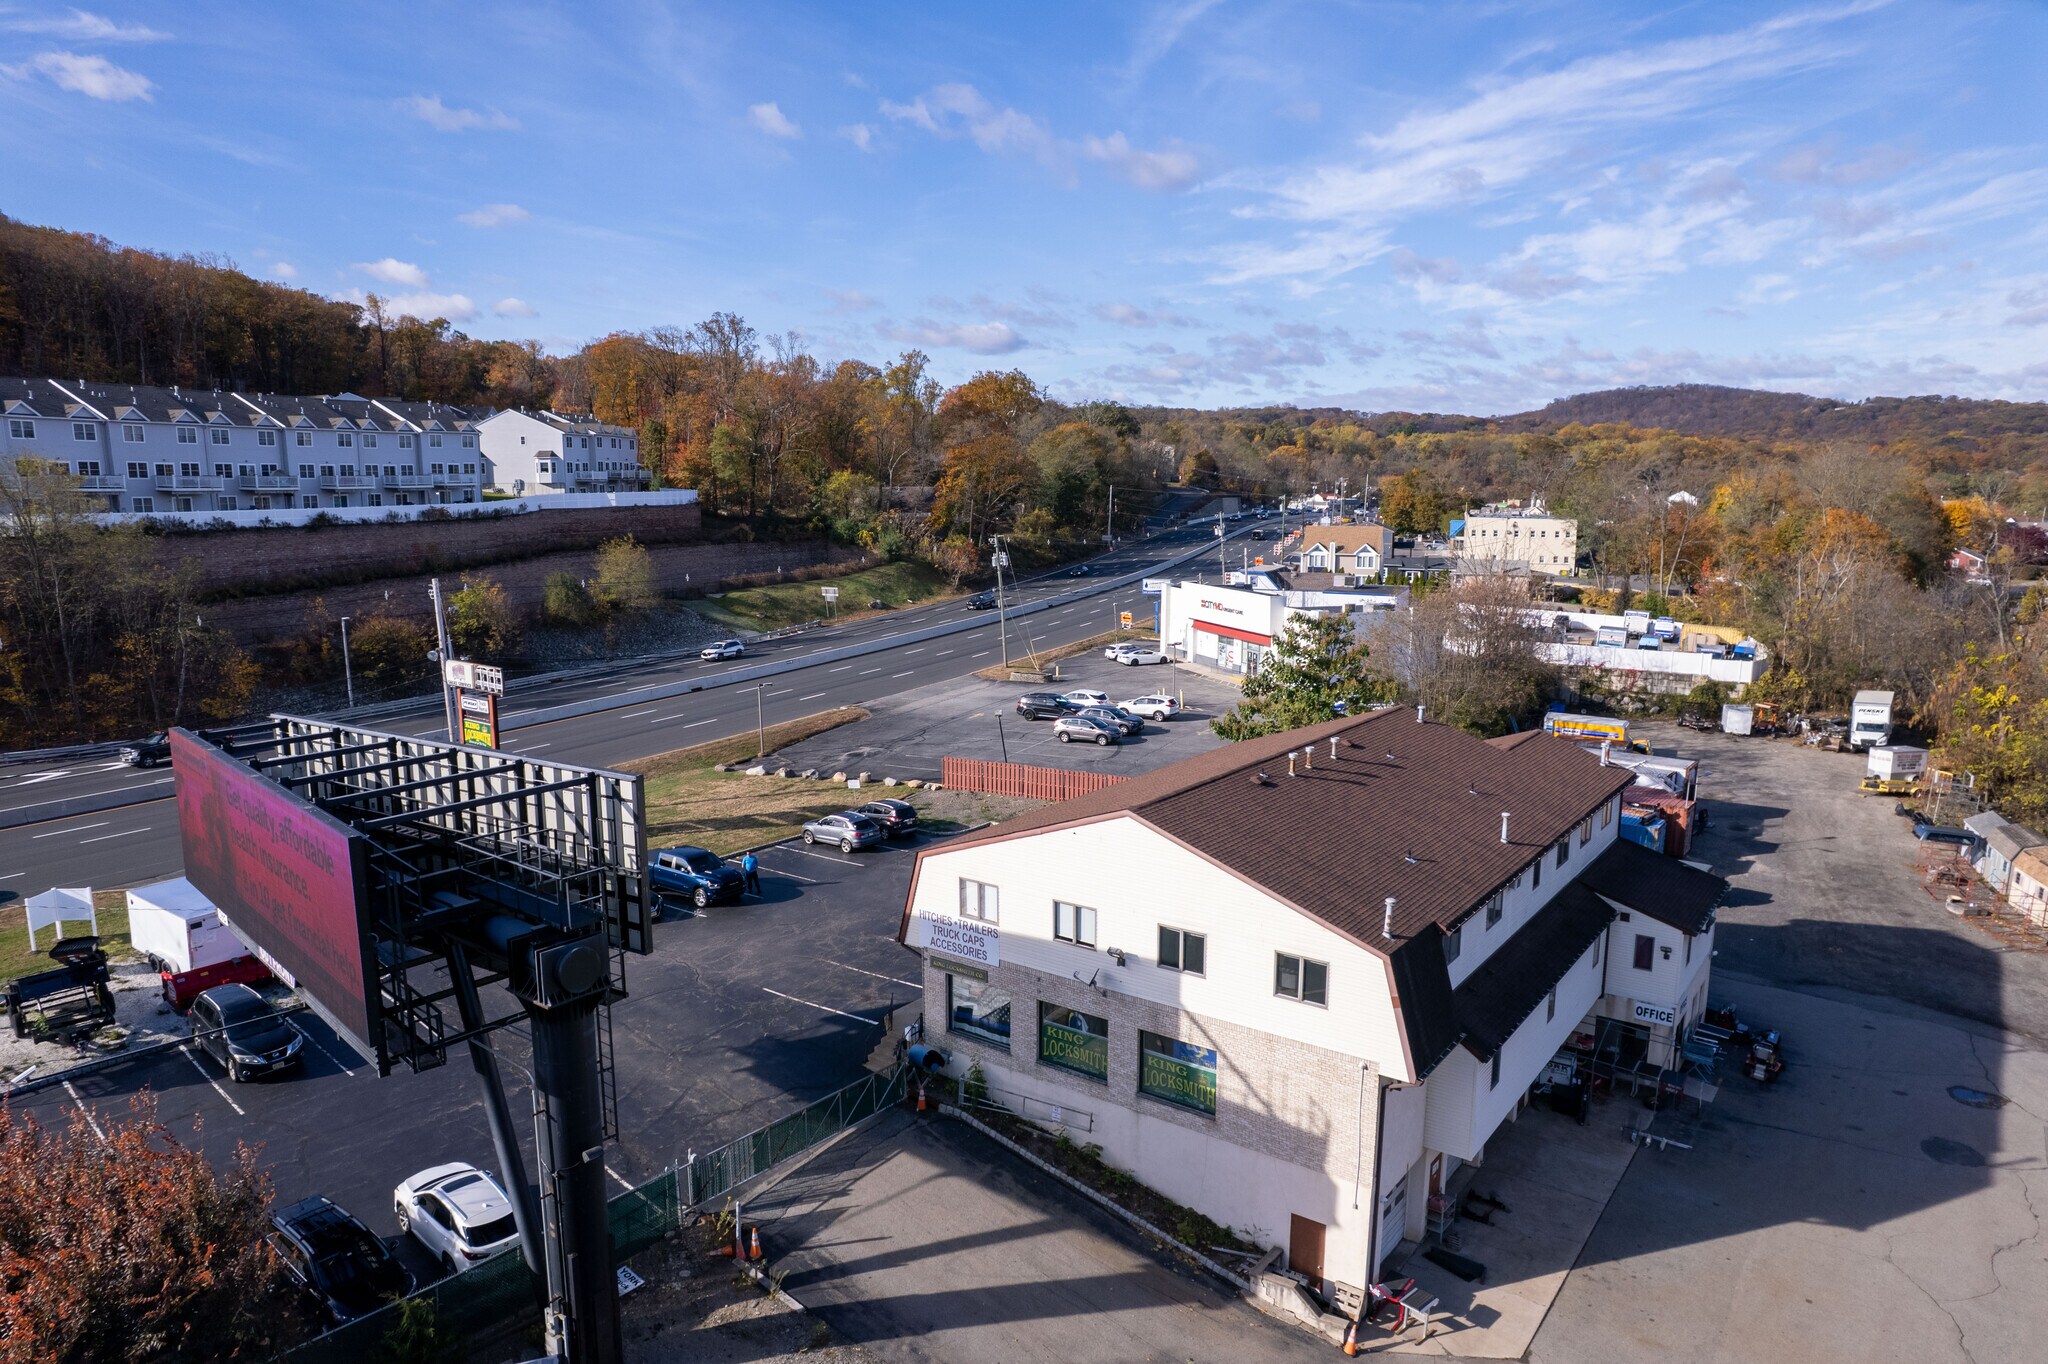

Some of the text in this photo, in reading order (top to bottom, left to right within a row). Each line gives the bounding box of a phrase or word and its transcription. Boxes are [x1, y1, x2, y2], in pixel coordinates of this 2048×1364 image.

[465, 721, 480, 730] KING
[225, 779, 243, 812] Get
[279, 817, 335, 877] affordable
[231, 825, 312, 901] health insurance.
[919, 909, 999, 939] HITCHES TRAILERS
[932, 925, 985, 948] TRUCK CAPS
[930, 937, 988, 961] ACCESSORIES
[933, 960, 945, 968] KING
[946, 964, 975, 977] LOCKSMITH
[1635, 1006, 1673, 1023] OFFICE
[1047, 1026, 1084, 1046] KING
[1043, 1037, 1108, 1073] LOCKSMITH
[1147, 1056, 1188, 1077] KING
[1143, 1067, 1216, 1109] LOCKSMITH
[620, 1268, 640, 1287] YORK
